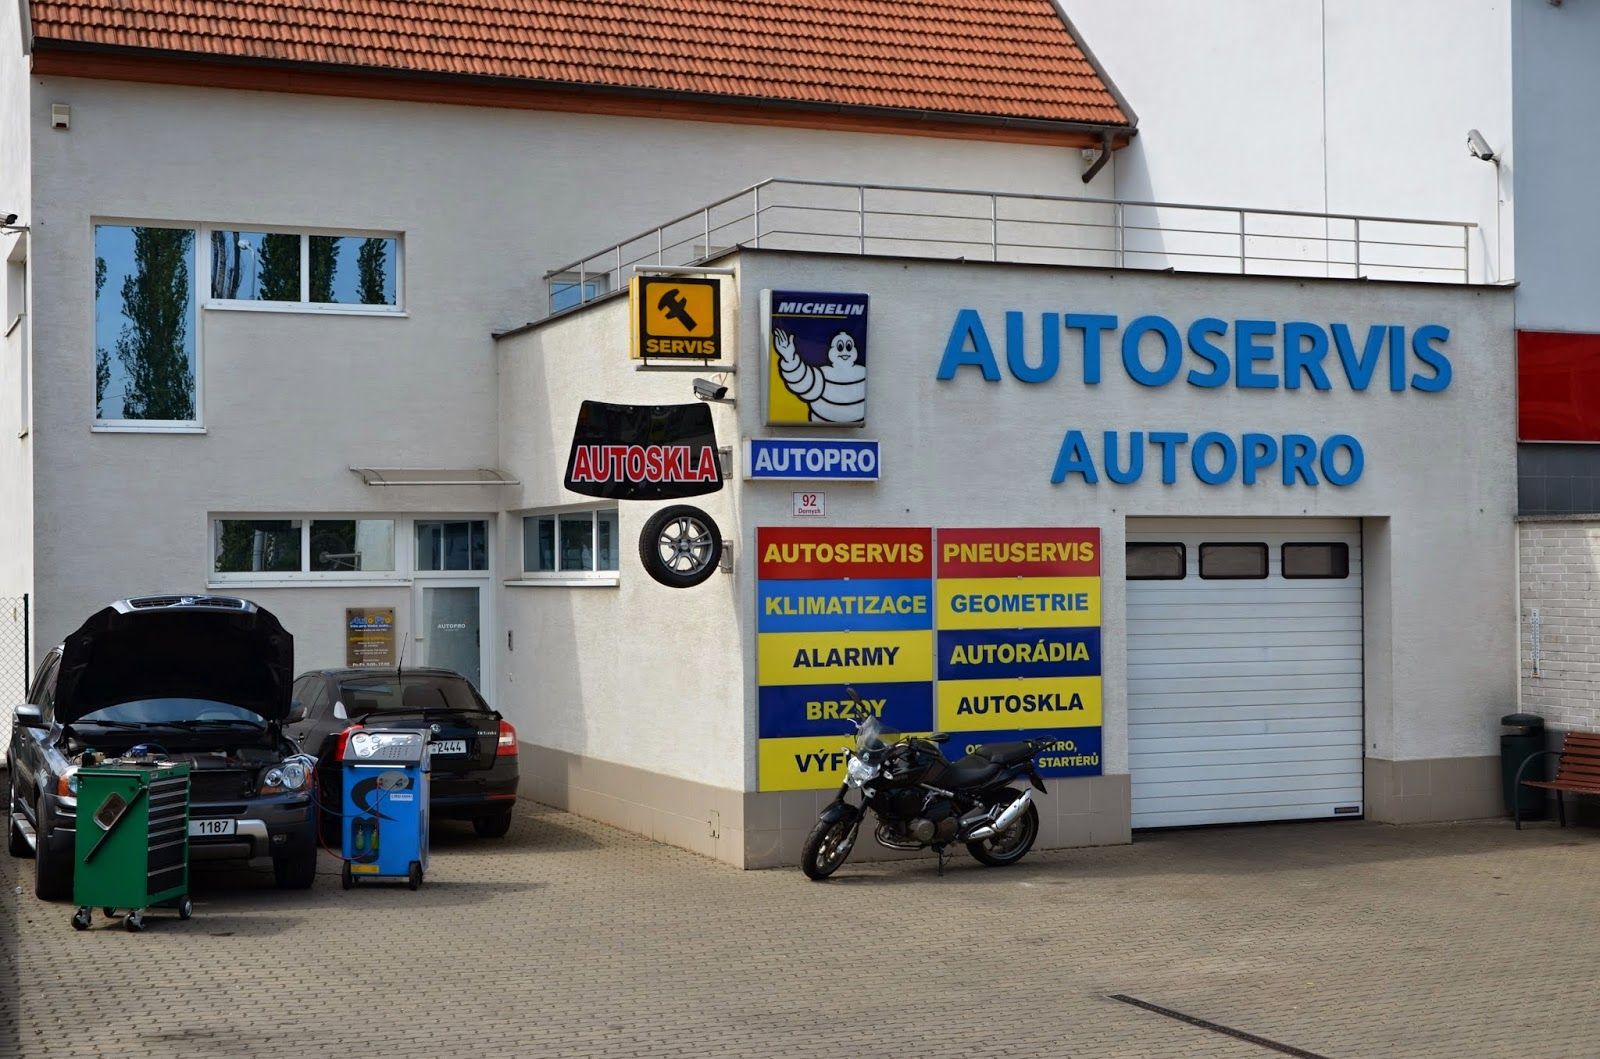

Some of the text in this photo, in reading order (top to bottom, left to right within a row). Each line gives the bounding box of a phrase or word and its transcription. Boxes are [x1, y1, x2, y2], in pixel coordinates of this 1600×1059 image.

[777, 301, 866, 316] MICHELIN
[646, 338, 716, 355] SERVIS
[936, 308, 1452, 392] AUTOSERVIS
[570, 444, 719, 483] AUTOSKLA
[755, 447, 876, 472] AUTOPRO
[1050, 430, 1365, 486] AUTOPRO
[798, 507, 821, 515] Dornych
[802, 494, 817, 507] 92
[764, 543, 924, 564] AUTOSERVIS
[943, 541, 1094, 563] PNEUSERVIS
[765, 594, 927, 616] KLIMATIZACE
[950, 593, 1089, 614] GEOMETRIE
[793, 646, 900, 668] ALARMY
[950, 639, 1090, 666] AUTORÁDIA
[957, 692, 1084, 716] AUTOSKLA
[438, 741, 462, 753] 2444
[1038, 752, 1099, 769] STARTÉRŮ
[199, 821, 229, 834] 1187
